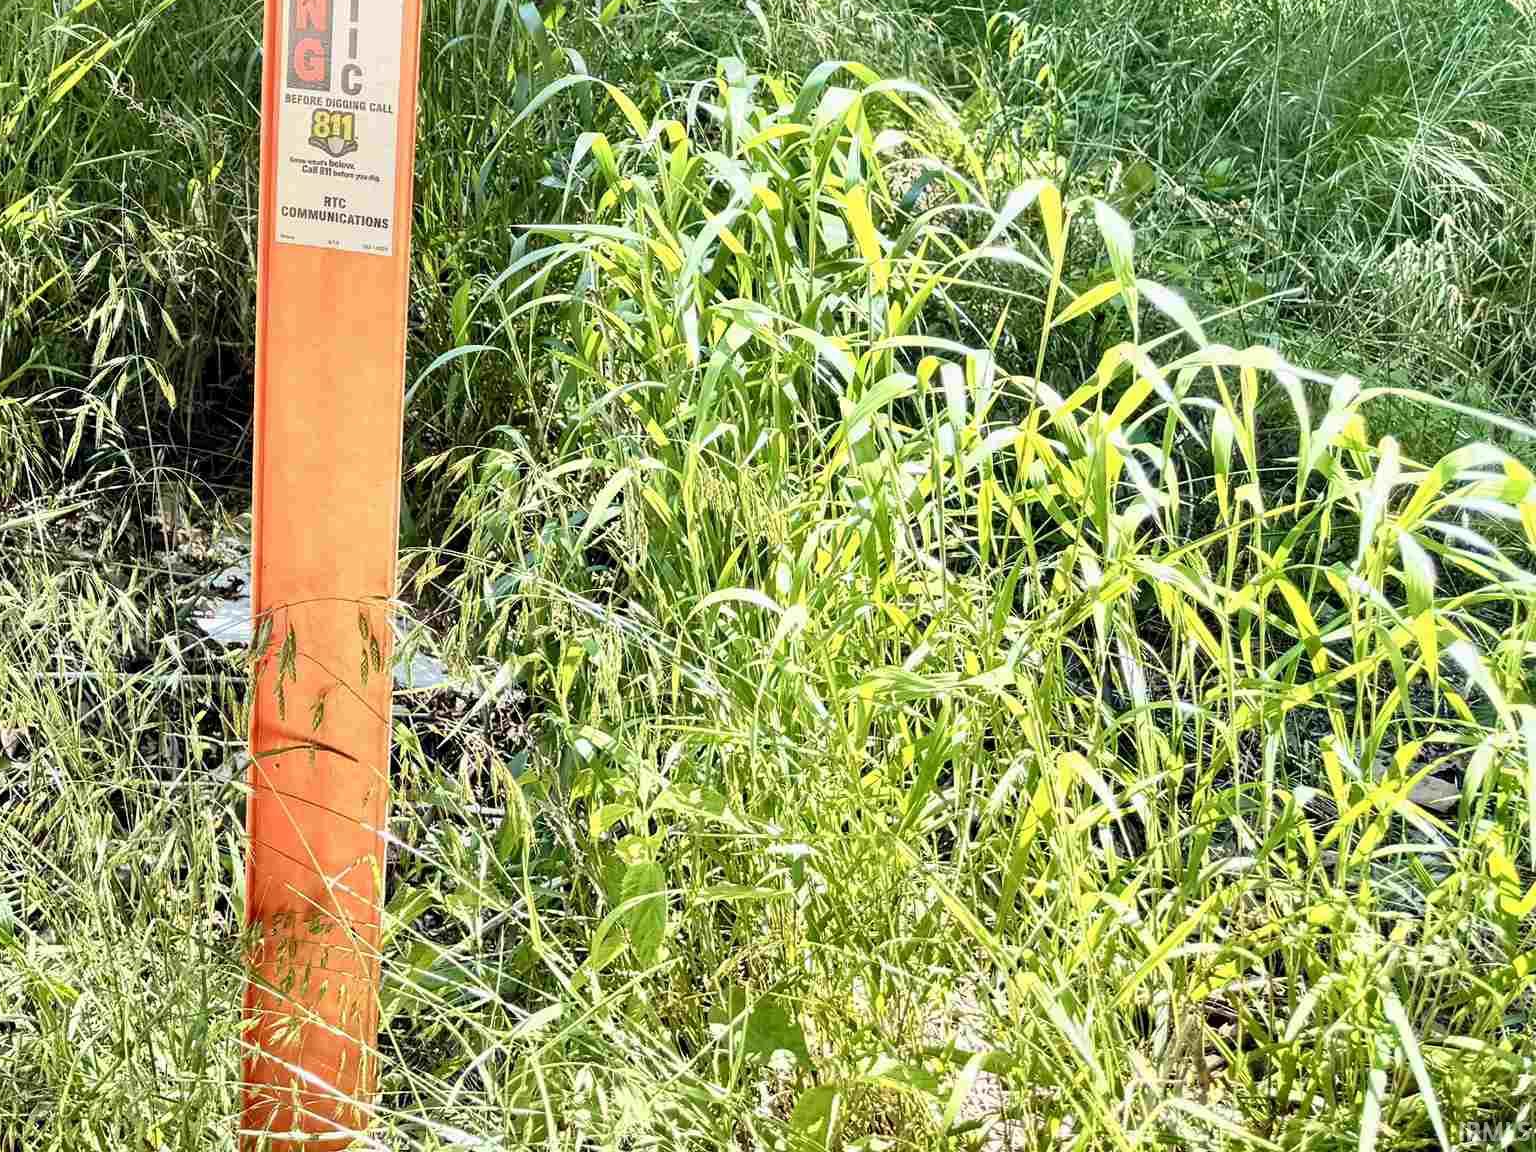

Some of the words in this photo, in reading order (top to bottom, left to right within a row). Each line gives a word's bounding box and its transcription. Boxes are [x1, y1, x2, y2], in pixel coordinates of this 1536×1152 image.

[285, 95, 323, 105] BEFORE
[325, 99, 367, 111] DIGGING
[369, 102, 393, 113] CALL
[312, 109, 354, 141] 811
[324, 196, 346, 208] RTC
[281, 206, 389, 229] COMMUNICATIONS
